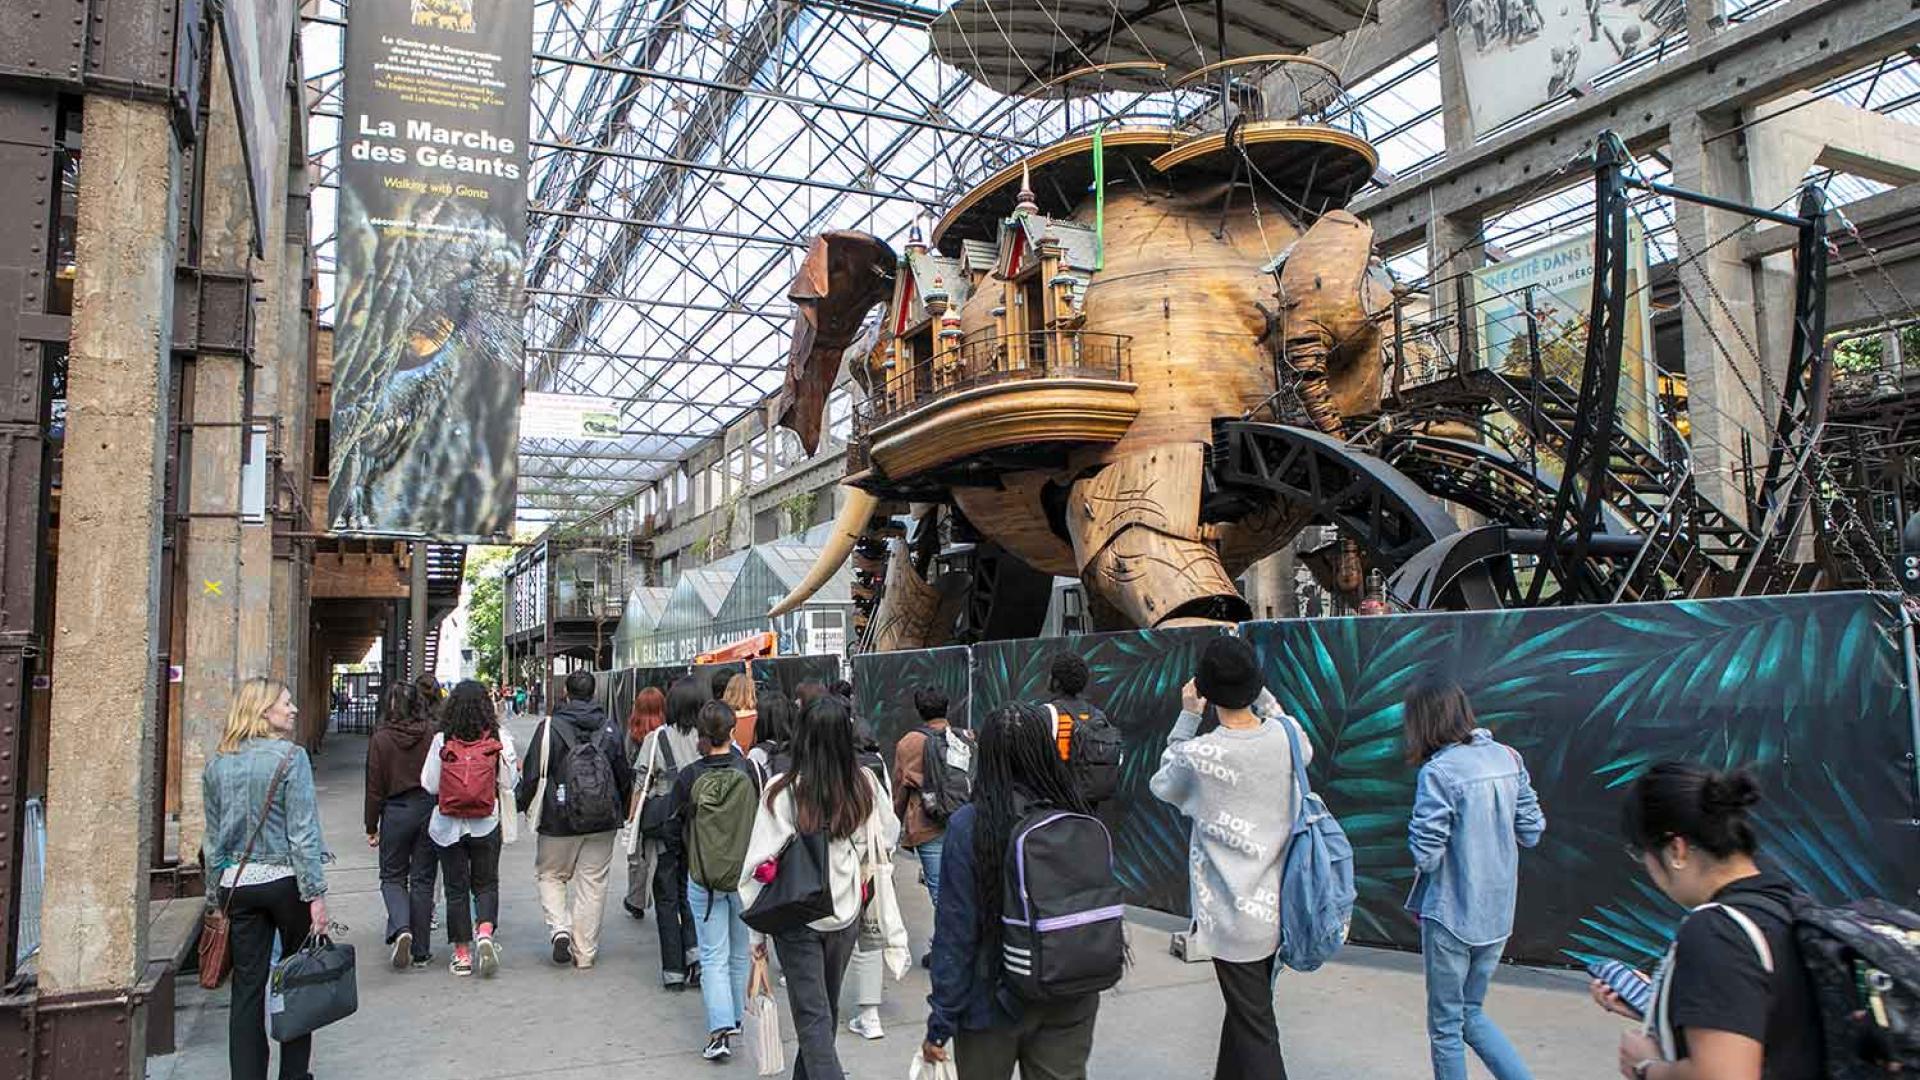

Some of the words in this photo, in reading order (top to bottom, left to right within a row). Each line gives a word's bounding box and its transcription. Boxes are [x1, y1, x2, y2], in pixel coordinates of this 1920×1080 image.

[359, 114, 396, 138] La
[406, 119, 516, 154] Marche
[351, 140, 407, 164] des
[415, 146, 521, 179] Géants
[383, 176, 427, 194] Walking
[430, 183, 453, 197] with
[455, 185, 490, 200] Giants
[1511, 257, 1539, 280] CITÉ
[1543, 247, 1582, 271] DANS
[1545, 276, 1564, 288] AUX
[1567, 266, 1593, 281] HÉRO
[679, 637, 697, 660] DES
[1183, 741, 1229, 762] BOY
[1216, 812, 1258, 837] BOY
[1197, 818, 1268, 862] LONDON
[1253, 886, 1277, 906] BO
